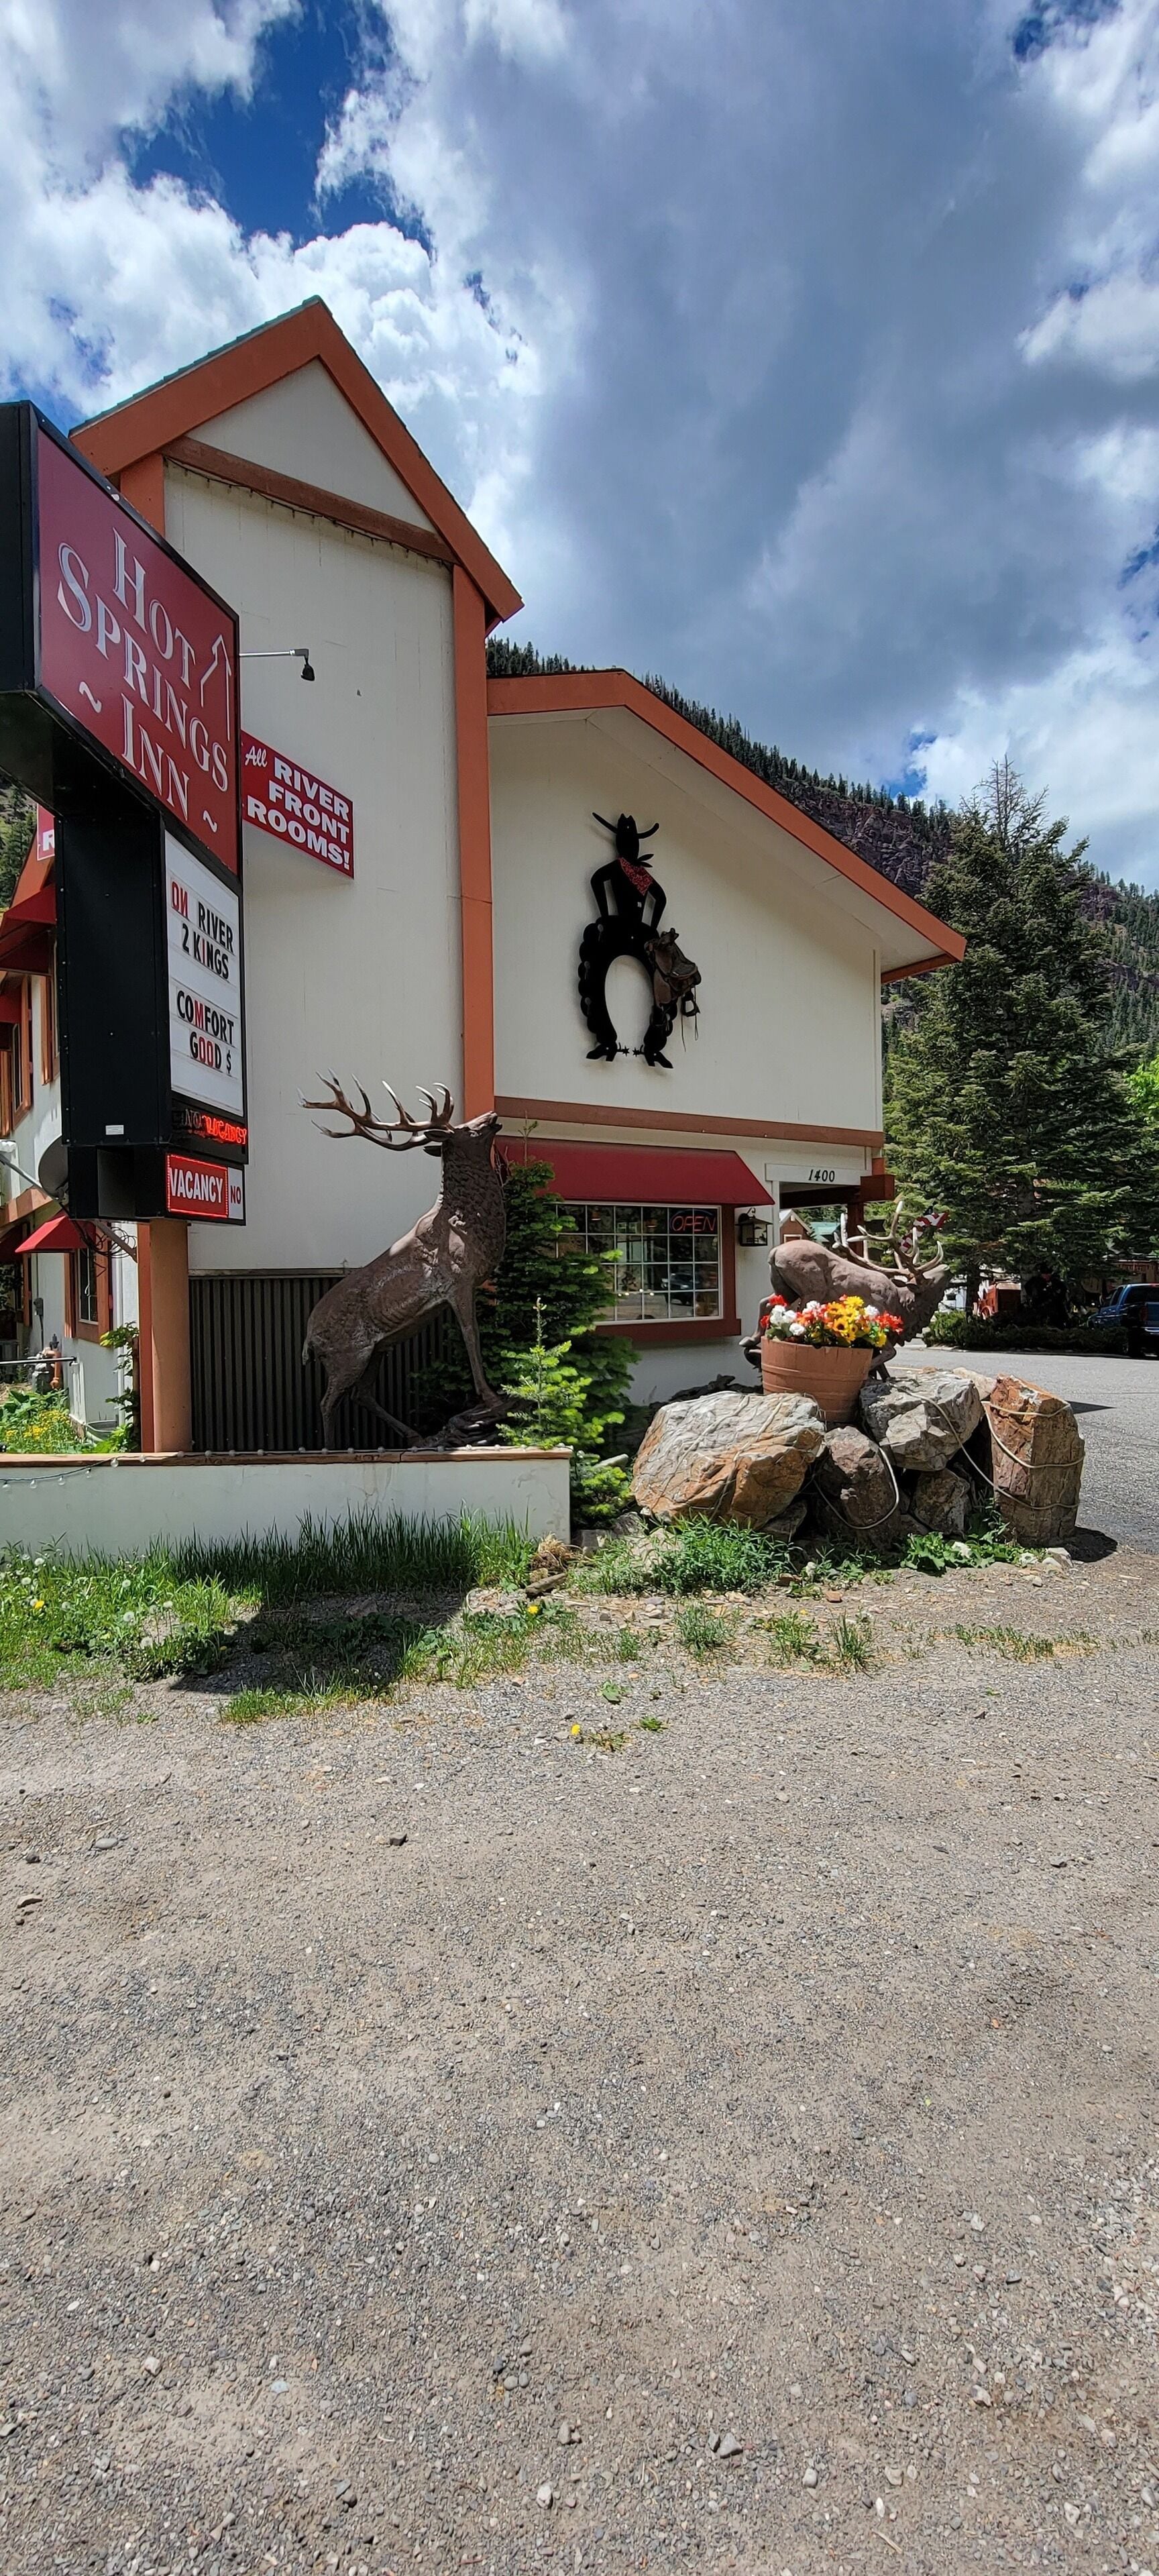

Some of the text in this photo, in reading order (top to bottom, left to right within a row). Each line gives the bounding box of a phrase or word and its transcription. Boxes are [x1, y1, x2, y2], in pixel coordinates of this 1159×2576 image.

[113, 527, 196, 690] HOT
[58, 542, 229, 792] SPRINGS
[121, 692, 190, 821] INN
[245, 745, 349, 822] All RIVER
[247, 795, 349, 870] ROOMS!
[269, 780, 349, 845] FRONT
[182, 923, 229, 979] 2 KINGS
[198, 901, 233, 953] RIVER
[177, 990, 234, 1044] COMFORT
[190, 1032, 231, 1074] GOOD $
[168, 1167, 242, 1205] VACANCY NO
[808, 1169, 835, 1182] 1400
[671, 1216, 716, 1232] OPEN
